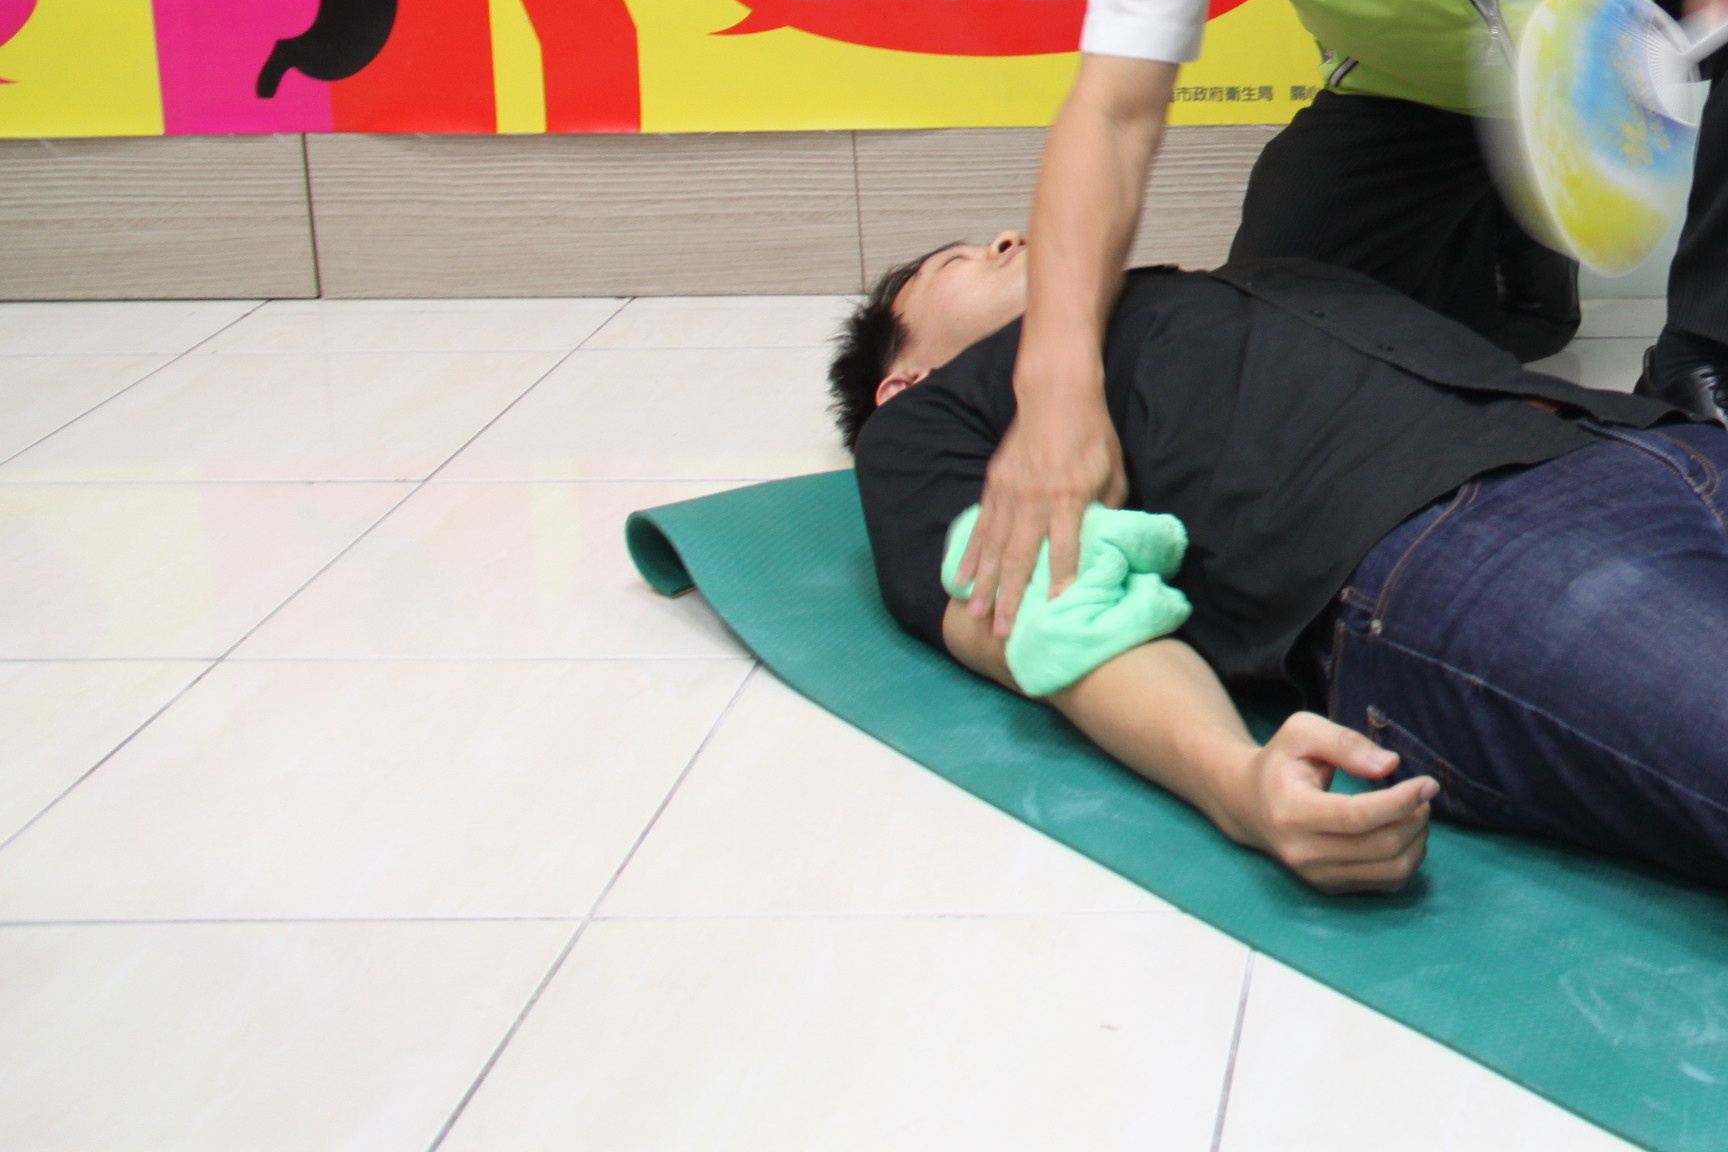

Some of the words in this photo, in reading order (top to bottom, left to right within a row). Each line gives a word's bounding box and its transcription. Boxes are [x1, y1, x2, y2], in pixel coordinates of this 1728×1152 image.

[1171, 85, 1273, 102] 市政府衛生局
